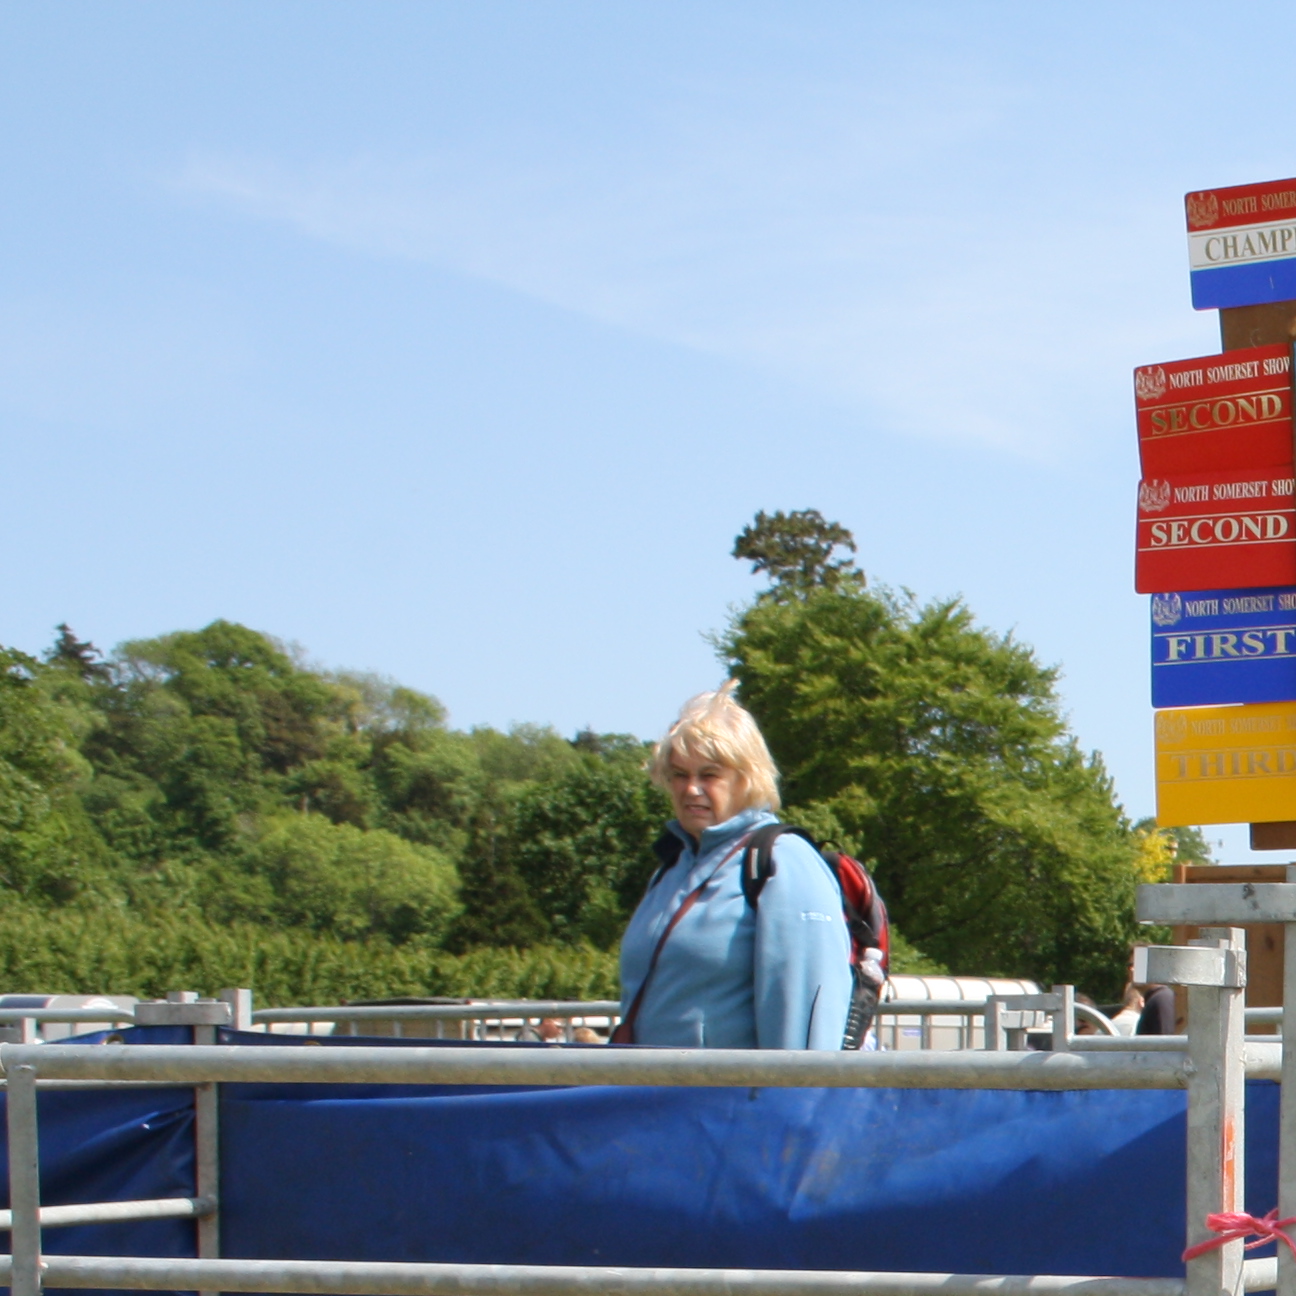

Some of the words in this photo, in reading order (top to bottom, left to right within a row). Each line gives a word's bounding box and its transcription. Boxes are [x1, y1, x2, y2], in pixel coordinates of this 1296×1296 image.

[1222, 196, 1258, 216] NORTH
[1169, 369, 1203, 389] NORTH
[1207, 360, 1260, 384] SOMERSET
[1151, 393, 1283, 435] SECOND
[1174, 485, 1209, 504] NORTH
[1213, 481, 1268, 501] SOMERSET
[1271, 478, 1295, 496] SHO
[1151, 514, 1289, 547] SECOND
[1185, 599, 1219, 617] NORTH
[1223, 595, 1274, 614] SOMERSET
[1166, 629, 1296, 661] FIRST
[1191, 718, 1225, 736] NORTH
[1230, 714, 1281, 734] SOMERSET
